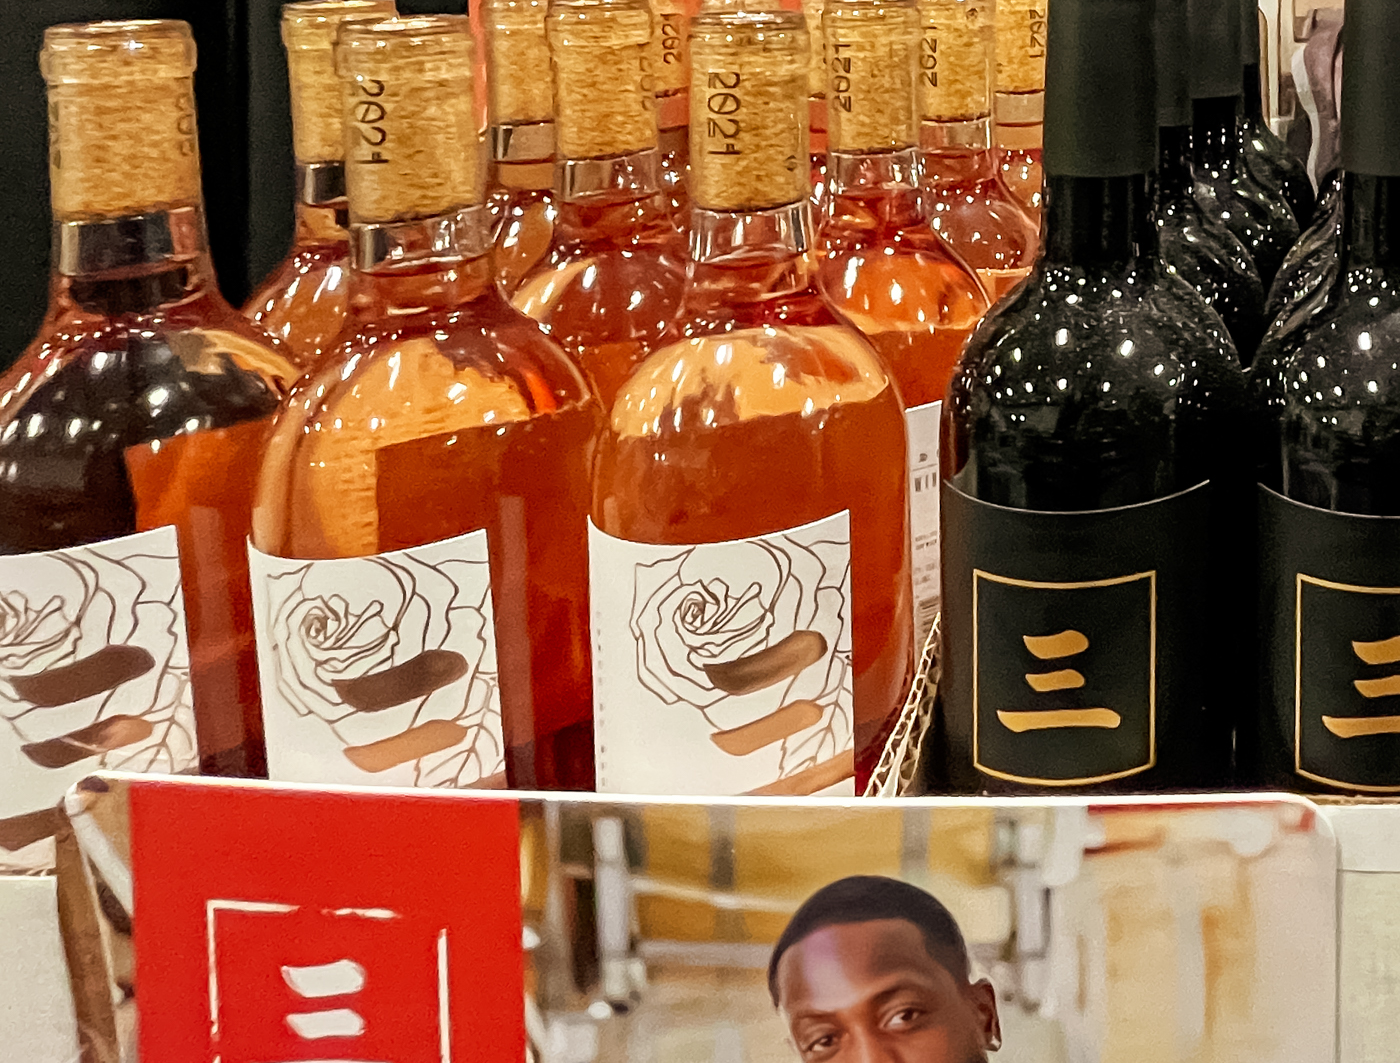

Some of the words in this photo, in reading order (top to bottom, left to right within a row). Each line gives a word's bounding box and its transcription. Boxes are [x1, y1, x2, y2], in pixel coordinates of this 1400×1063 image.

[707, 71, 742, 156] 2021
[831, 43, 852, 112] 2021
[356, 78, 390, 165] 2021
